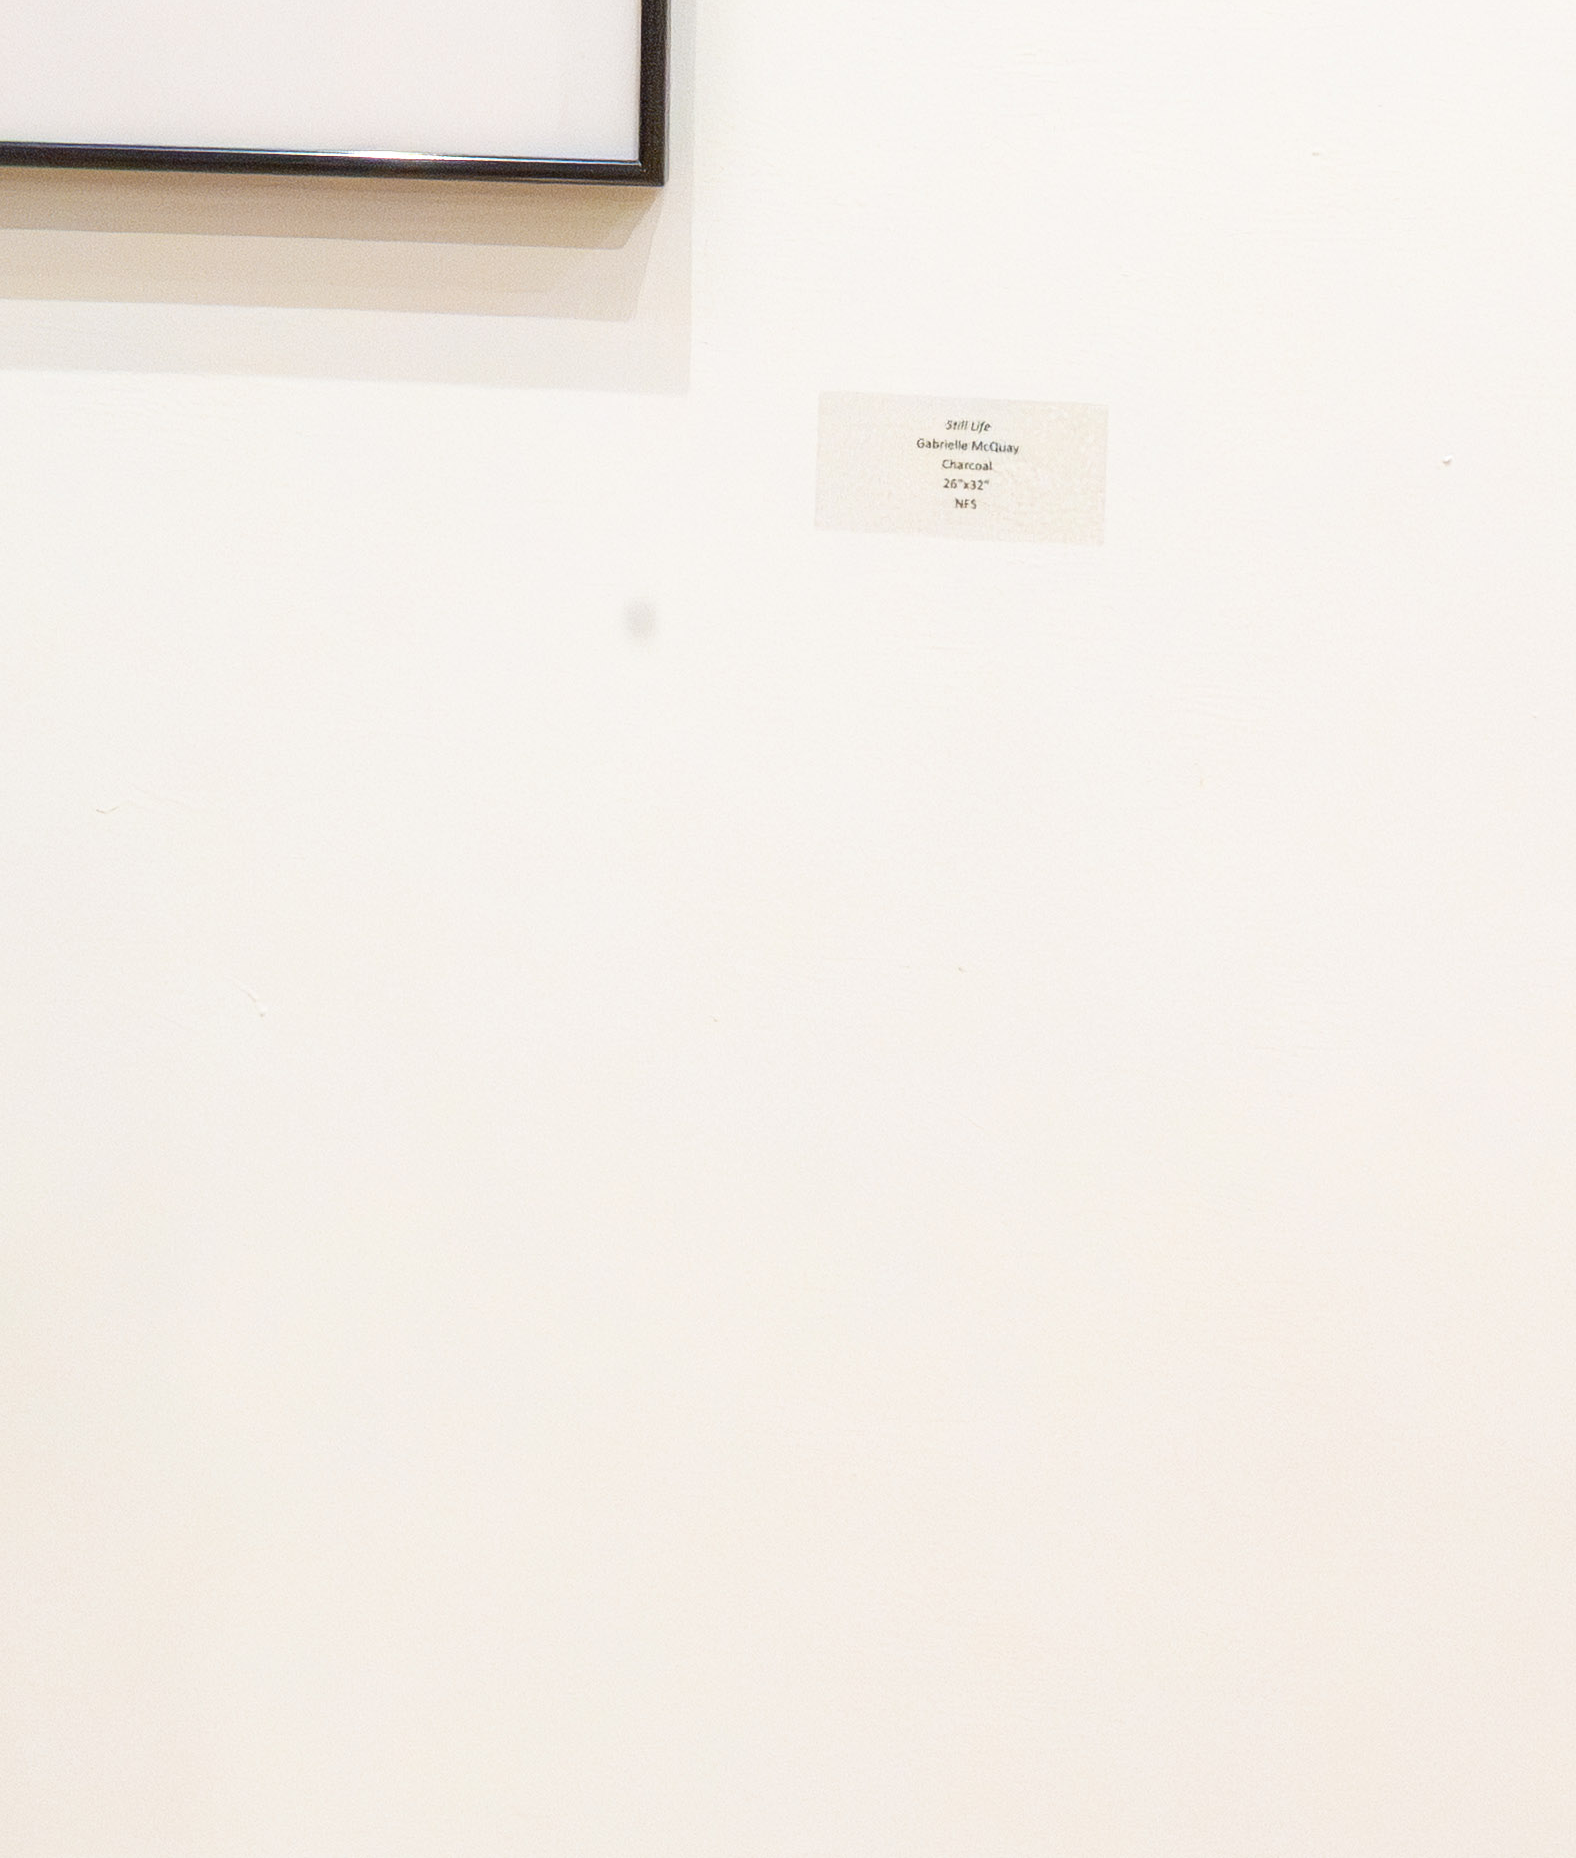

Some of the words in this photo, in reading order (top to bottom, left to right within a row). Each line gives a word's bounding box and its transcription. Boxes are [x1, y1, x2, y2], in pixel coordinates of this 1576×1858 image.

[945, 420, 968, 431] Still
[970, 421, 991, 433] Life
[916, 438, 968, 451] Gabrielle
[971, 441, 1019, 455] McQuay
[941, 459, 993, 471] Charcoal
[955, 498, 977, 510] NFS
